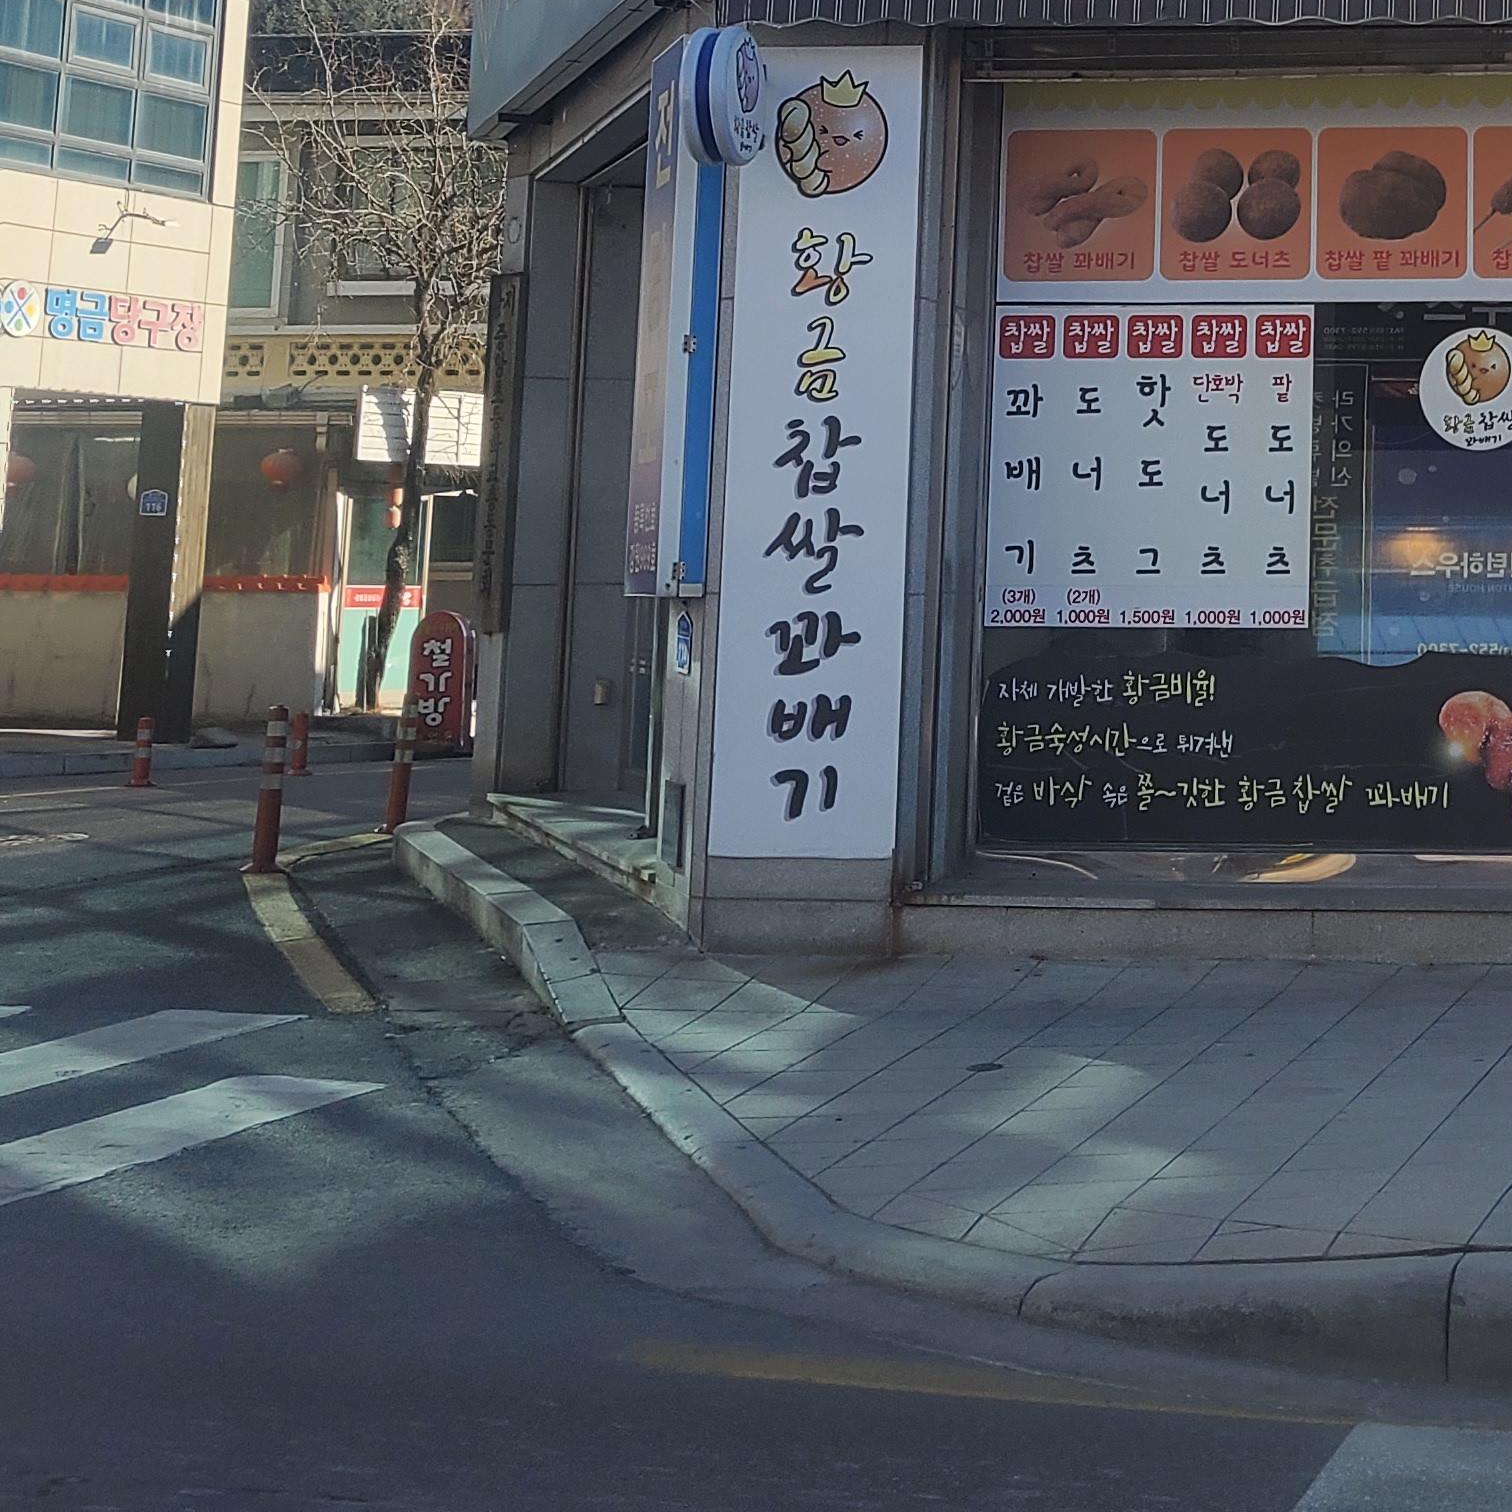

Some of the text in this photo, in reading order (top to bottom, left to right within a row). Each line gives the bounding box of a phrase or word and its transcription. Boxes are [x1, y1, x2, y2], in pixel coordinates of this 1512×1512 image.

[1023, 252, 1135, 274] 찹쌀 꽈배기
[1179, 251, 1291, 273] 찹쌀 도너츠
[1324, 250, 1460, 271] 찹쌀 팥 꽈배기
[1004, 319, 1050, 354] 찹쌀
[1068, 319, 1114, 354] 찹쌀
[1132, 319, 1178, 354] 찹쌀
[1196, 319, 1243, 354] 찹쌀
[1260, 319, 1306, 354] 찹쌀
[1192, 373, 1243, 404] 단호박
[1271, 373, 1292, 404] 팥
[1004, 384, 1044, 575] 꽈배기
[1071, 386, 1102, 575] 도너츠
[1135, 373, 1171, 575] 핫도그
[1200, 425, 1230, 575] 도너츠
[1265, 425, 1295, 575] 도너츠
[1001, 588, 1036, 606] (3개)
[1066, 588, 1101, 606] (2개)
[999, 669, 1215, 707] 자체 개발한 황금비율!
[996, 722, 1233, 758] 황금숙성시간으로 튀겨낸
[995, 782, 1024, 807] 겉은
[1033, 774, 1092, 808] 바삭
[1103, 782, 1128, 808] 속은
[1366, 781, 1448, 808] 꽈배기
